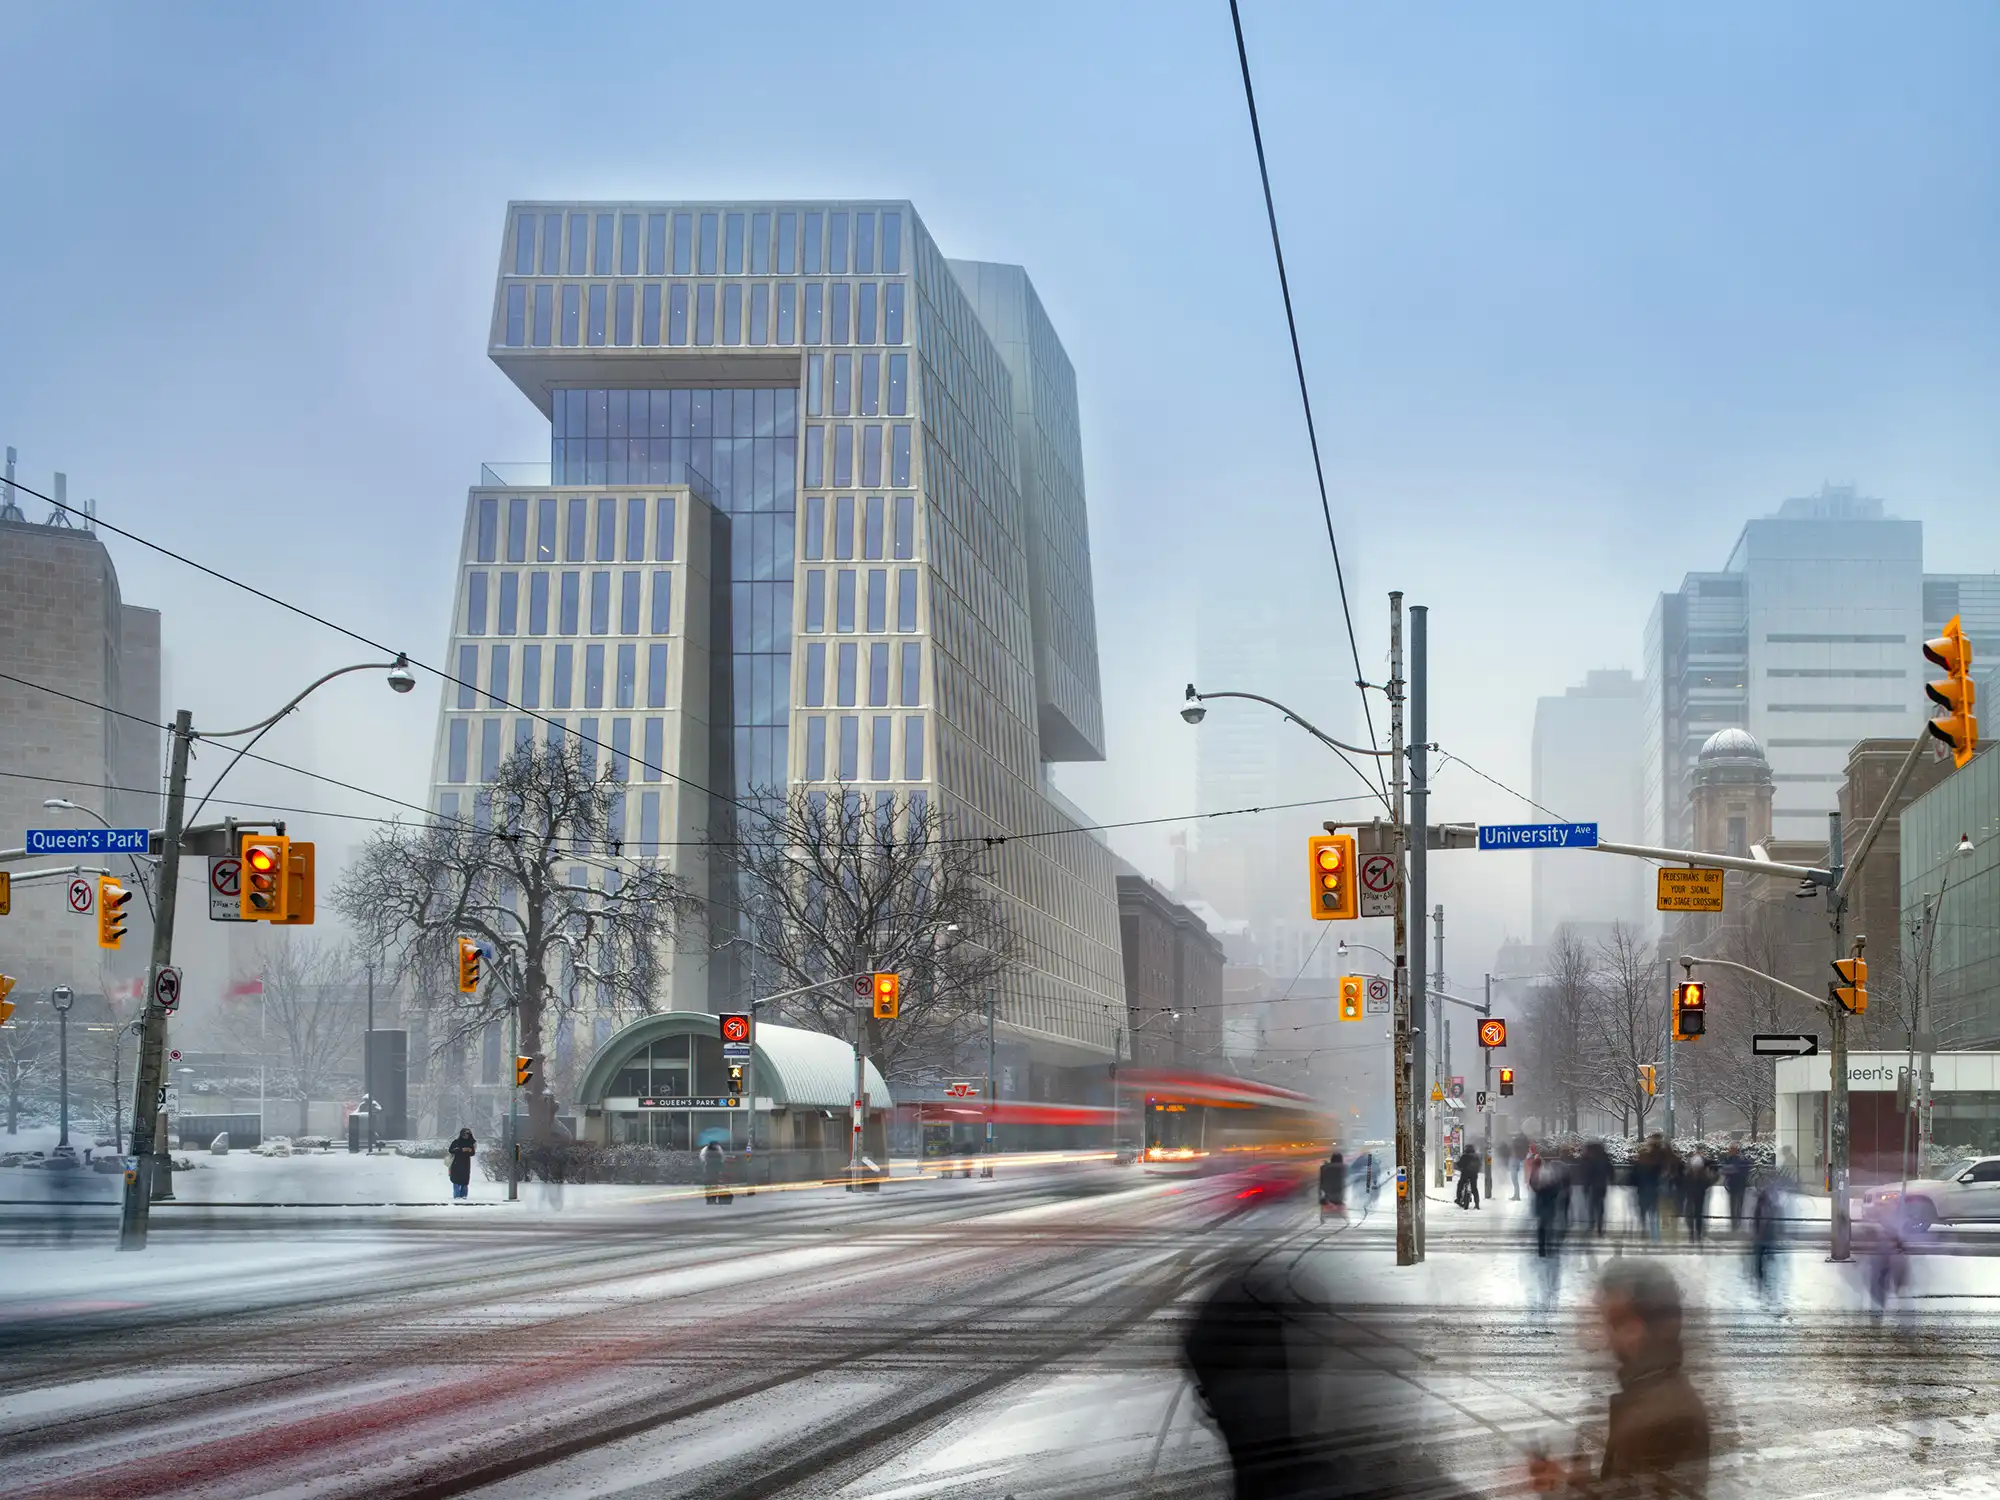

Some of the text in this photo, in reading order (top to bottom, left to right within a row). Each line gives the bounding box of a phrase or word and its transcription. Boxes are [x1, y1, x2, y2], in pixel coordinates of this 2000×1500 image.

[33, 831, 143, 849] Queen's Park
[1485, 825, 1591, 846] University Ave
[1663, 872, 1719, 883] PEDESTRIANS OBEY
[1670, 885, 1710, 894] YOUR SIGNAL
[1660, 897, 1720, 907] TWO STAGE CROSSING
[1829, 1066, 1893, 1080] ueen's
